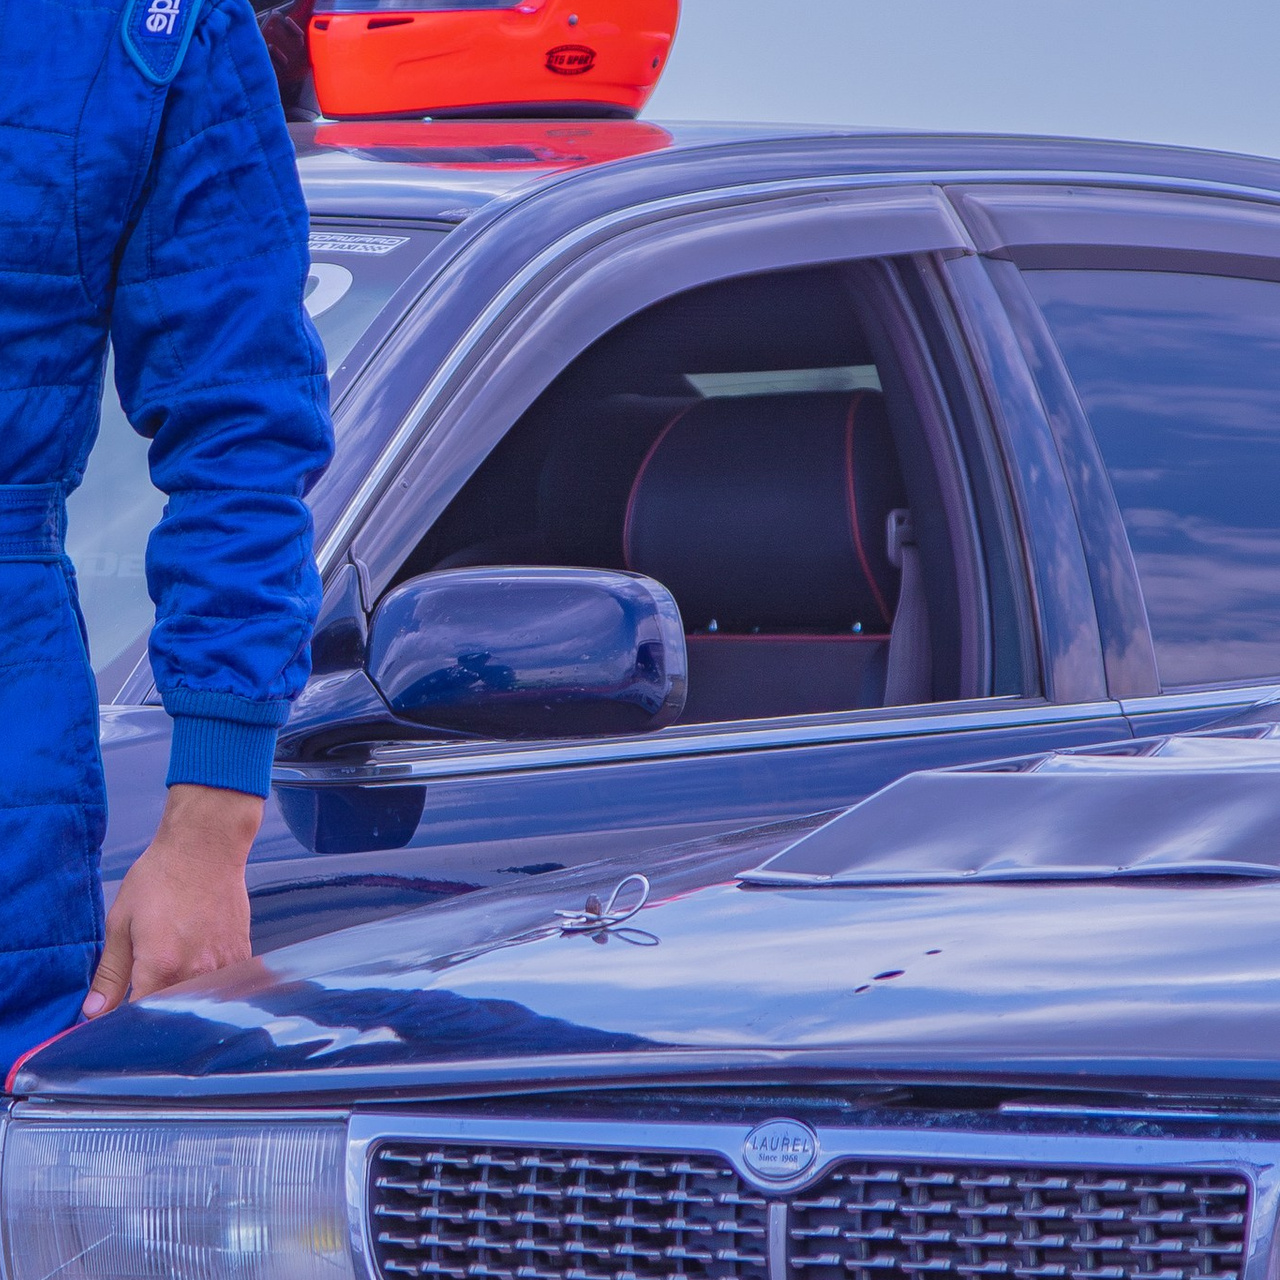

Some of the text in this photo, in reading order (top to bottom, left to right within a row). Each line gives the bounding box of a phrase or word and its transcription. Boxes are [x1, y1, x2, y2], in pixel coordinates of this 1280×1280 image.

[329, 242, 362, 250] TAXI
[751, 1136, 810, 1153] LAUREL
[758, 1152, 778, 1163] Since
